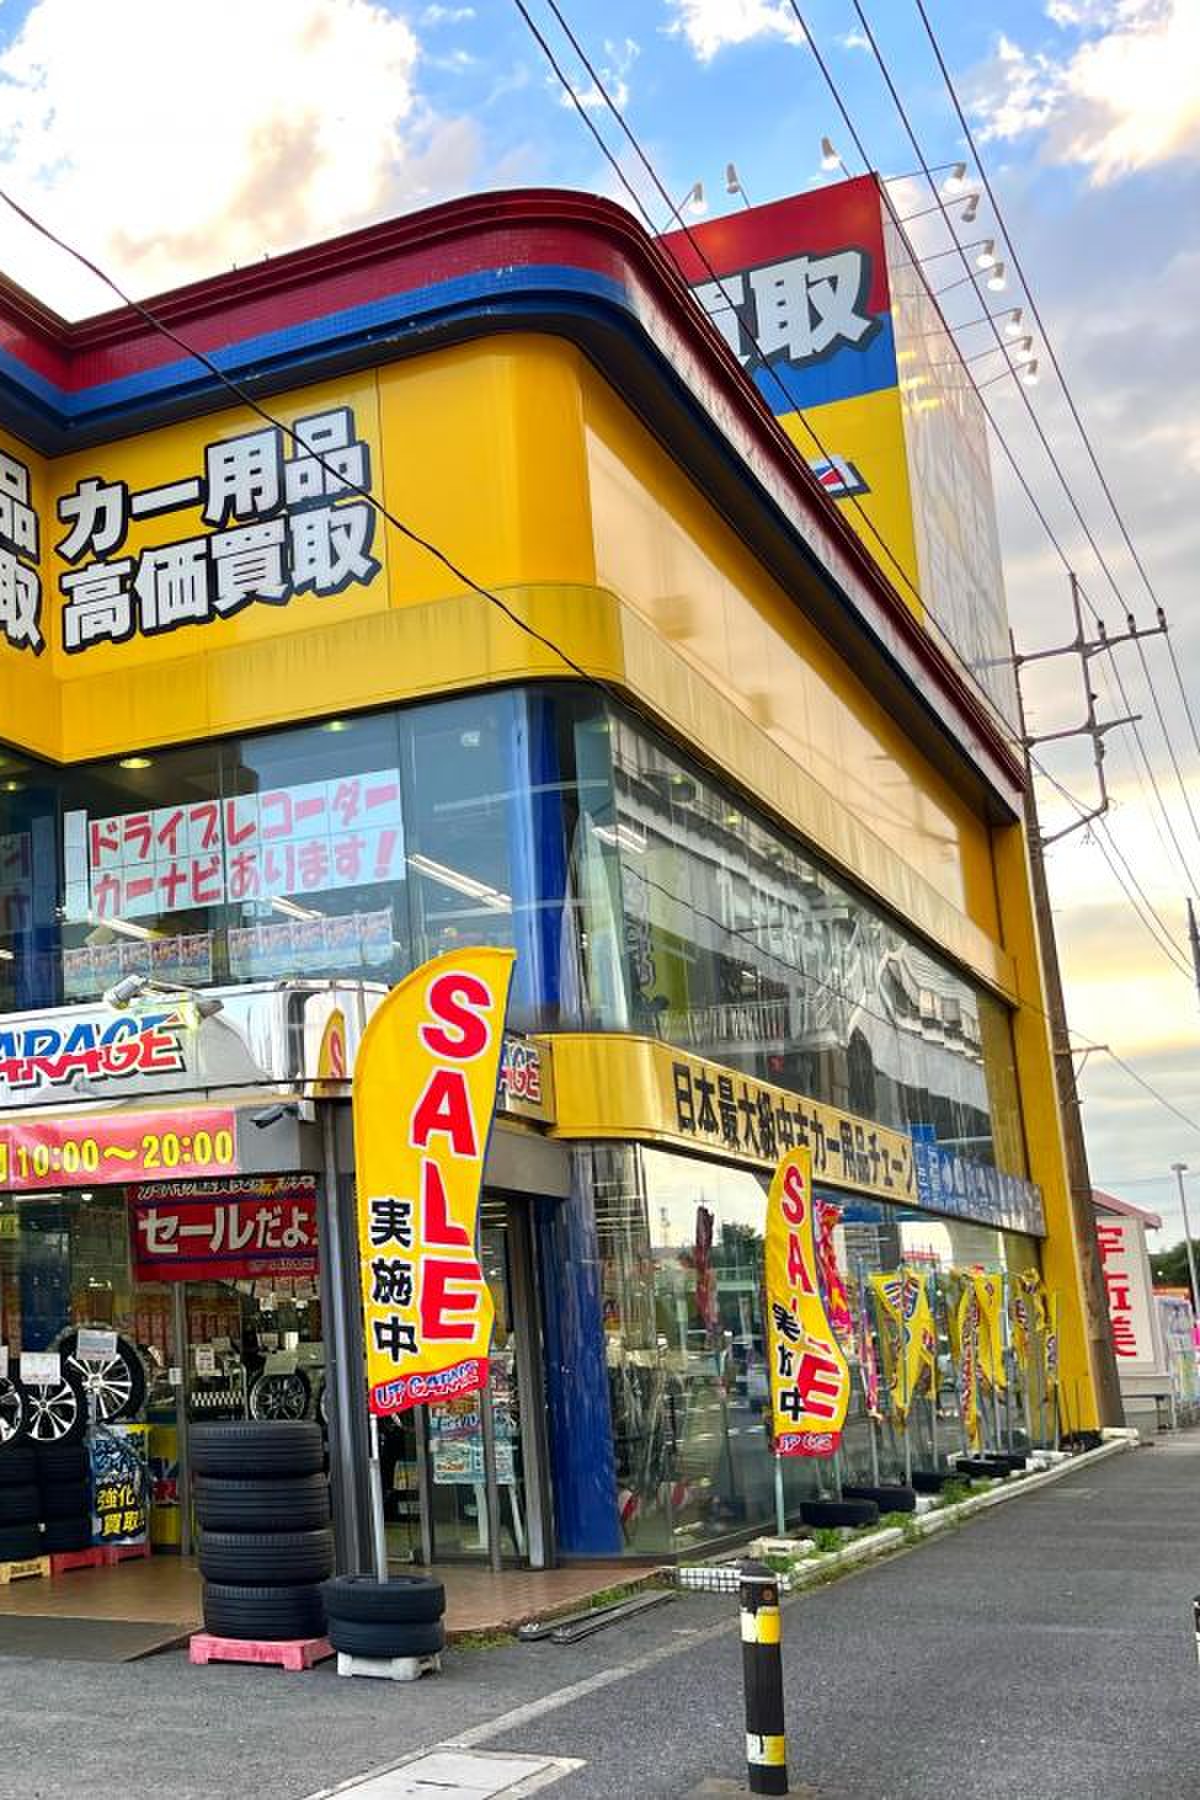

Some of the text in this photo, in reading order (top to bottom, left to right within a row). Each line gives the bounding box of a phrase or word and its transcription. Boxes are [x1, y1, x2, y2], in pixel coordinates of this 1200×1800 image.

[57, 406, 371, 562] カー用品
[59, 500, 382, 653] 高価買取
[91, 782, 398, 867] ドライブレコーダー
[500, 1041, 542, 1104] AGE
[410, 972, 492, 1341] SALE
[369, 1197, 418, 1363] 実施中
[782, 1164, 842, 1420] SAE
